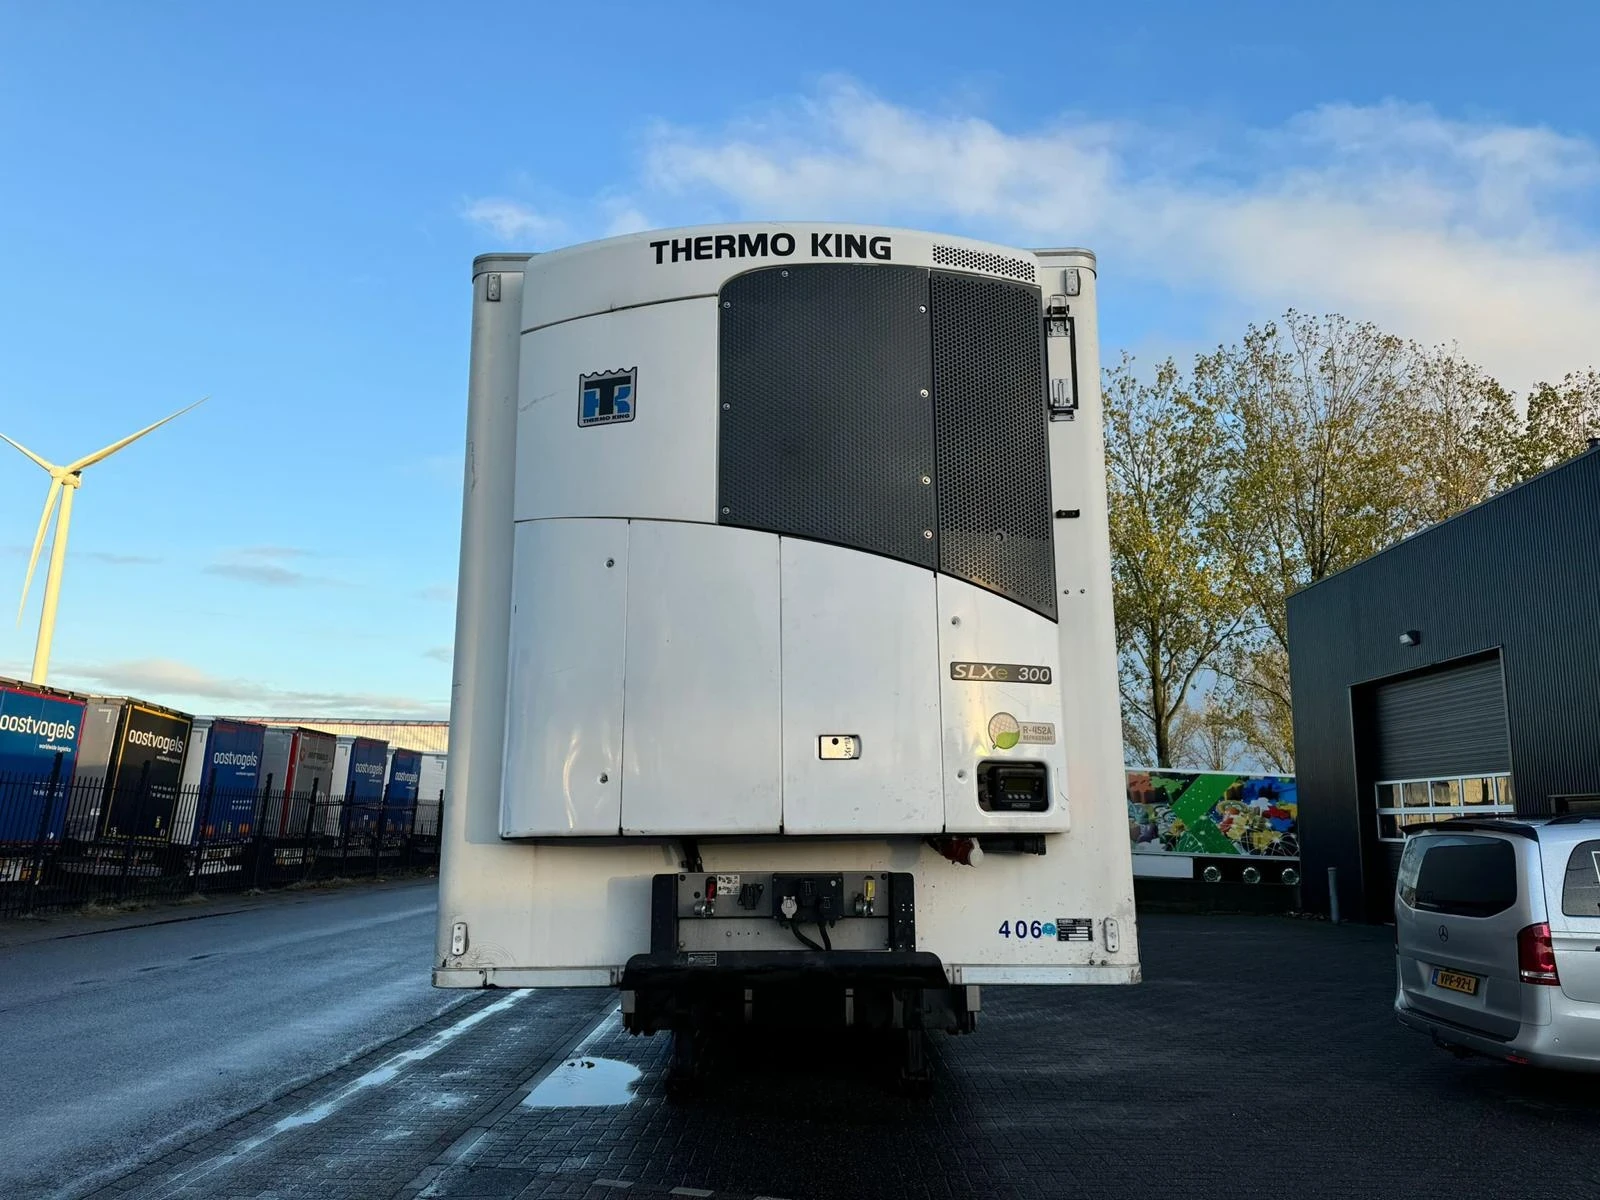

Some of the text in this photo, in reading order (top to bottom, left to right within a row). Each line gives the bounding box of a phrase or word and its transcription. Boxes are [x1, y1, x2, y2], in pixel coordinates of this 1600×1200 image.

[650, 232, 891, 264] THERMO KING
[582, 413, 630, 424] THERMO KING
[953, 664, 1050, 682] SLXe 300
[0, 714, 76, 742] oostvogels
[1022, 725, 1053, 735] R-452A
[39, 743, 57, 751] worldwide
[128, 729, 184, 754] oostvogels
[213, 751, 258, 770] oostvogels
[355, 762, 384, 777] oostvogels
[394, 771, 418, 785] oostvogels
[998, 919, 1042, 939] 406
[1440, 972, 1472, 991] VPF-92-L
